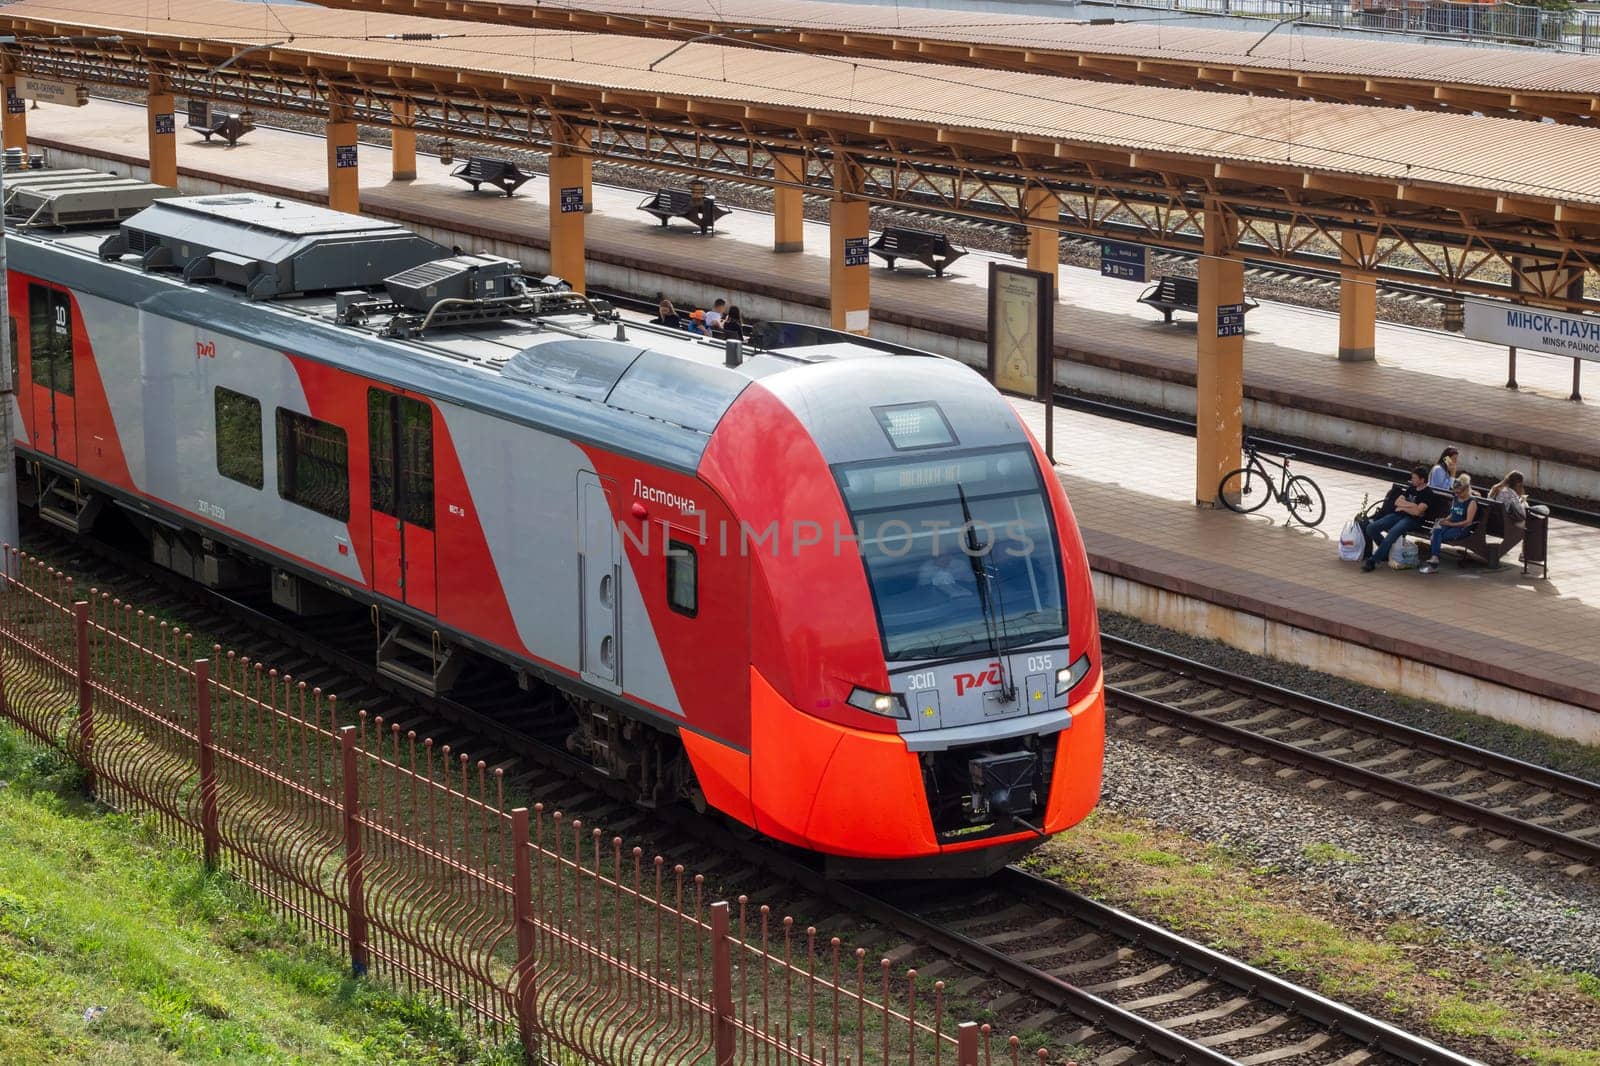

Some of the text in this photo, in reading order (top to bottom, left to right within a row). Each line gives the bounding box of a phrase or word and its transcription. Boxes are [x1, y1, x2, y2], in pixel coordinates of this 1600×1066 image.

[55, 305, 66, 326] 10
[1507, 311, 1600, 341] МІНСК-ПАЎН
[1542, 336, 1566, 348] MINSK
[633, 478, 696, 513] Ласточка
[1027, 655, 1053, 672] 035
